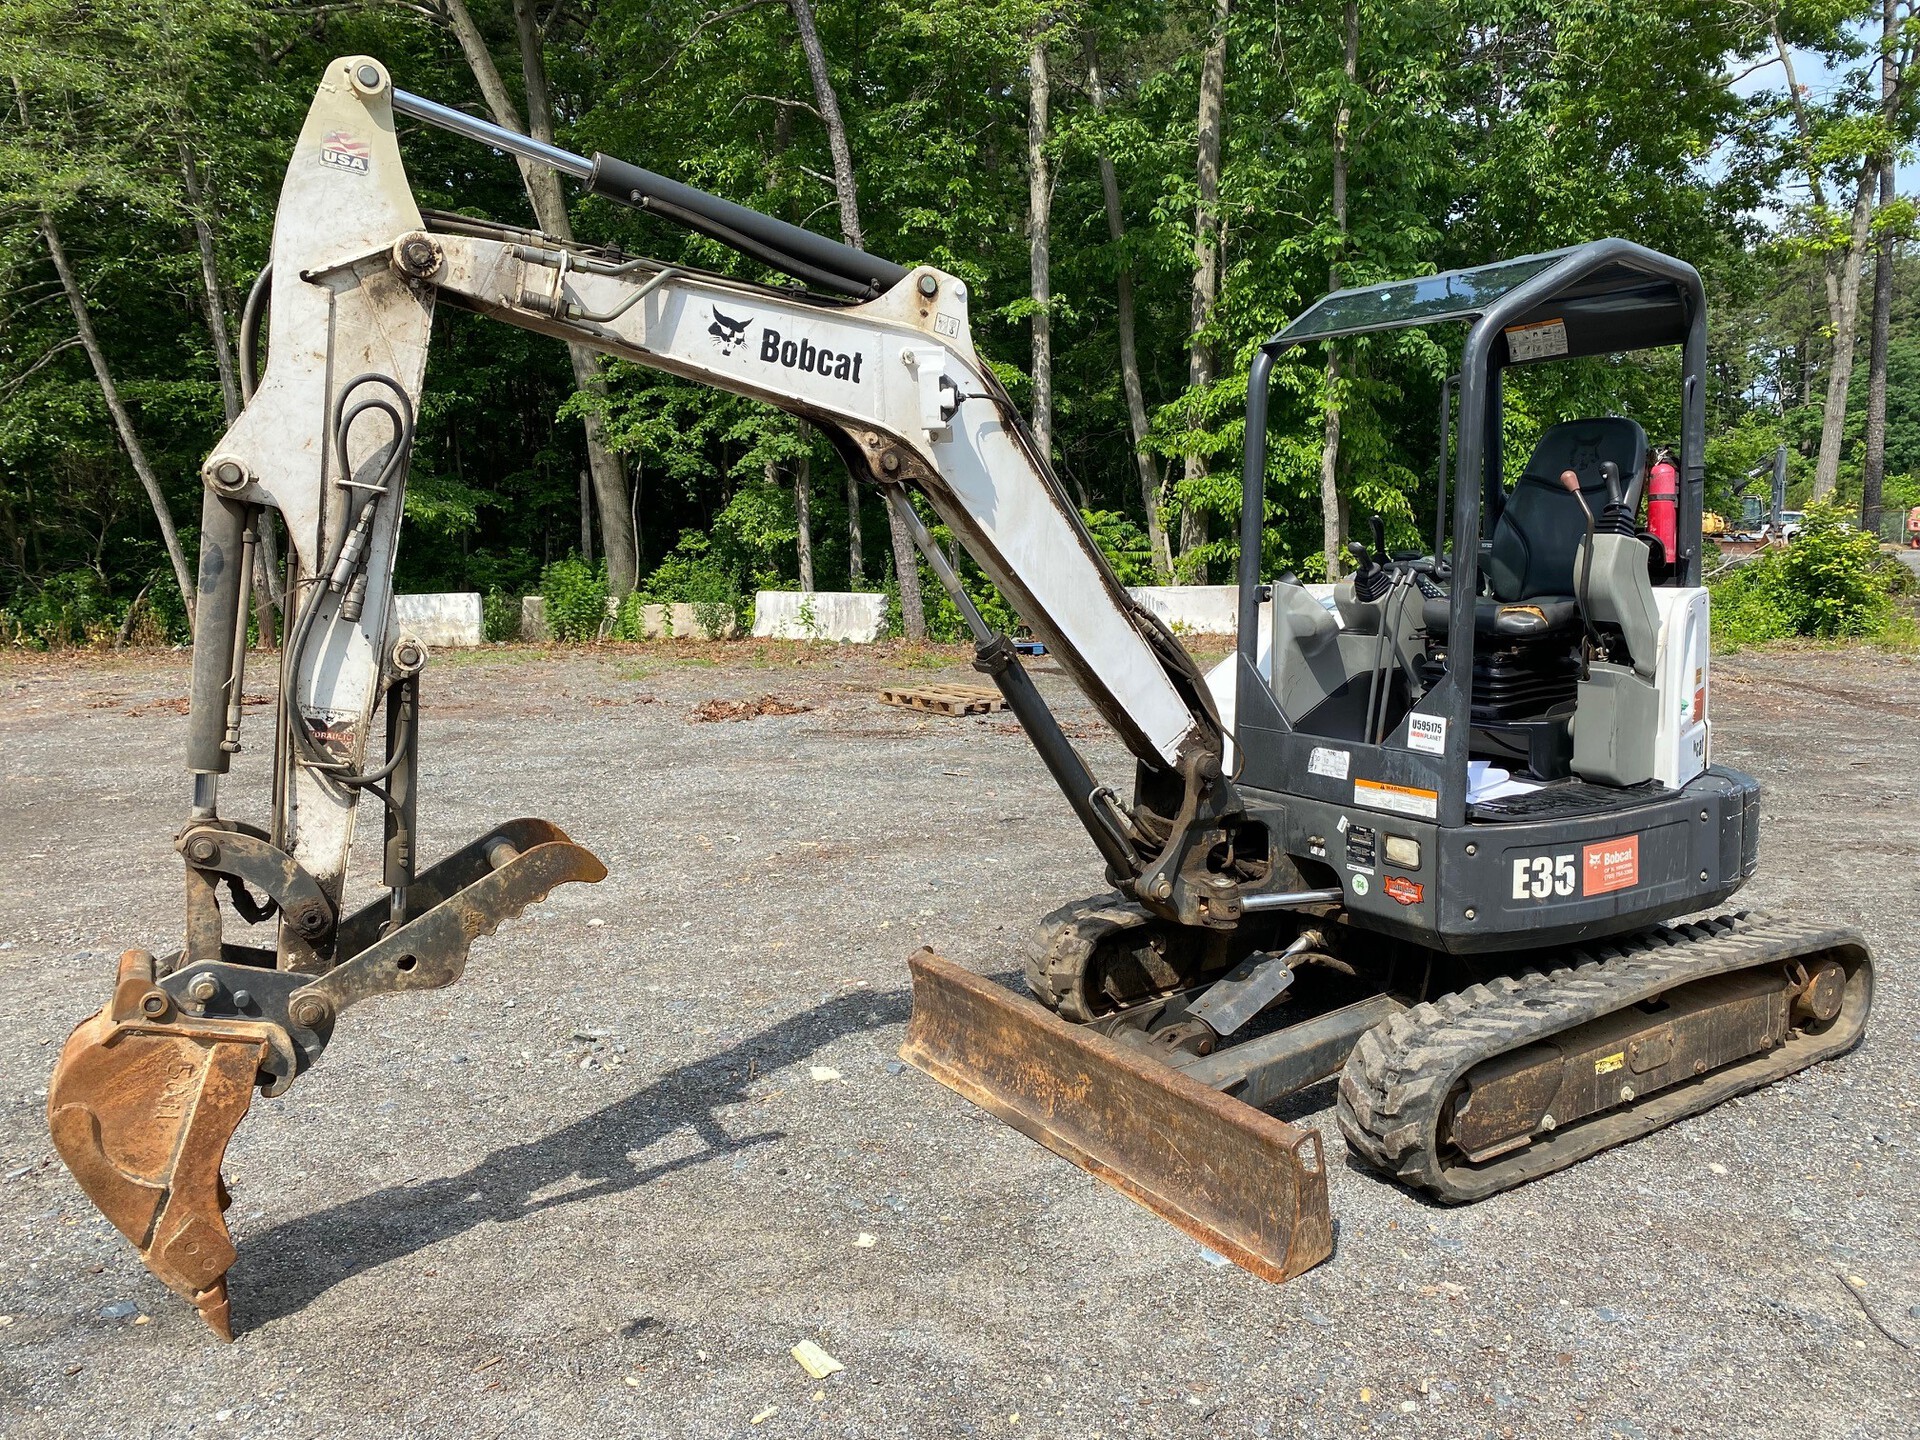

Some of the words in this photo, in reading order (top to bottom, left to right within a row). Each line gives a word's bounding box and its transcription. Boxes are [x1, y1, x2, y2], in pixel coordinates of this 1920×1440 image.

[323, 150, 365, 170] USA
[760, 328, 863, 384] Bobcat
[312, 731, 353, 741] DRAULIC
[1412, 719, 1442, 734] U595175
[1386, 785, 1410, 794] WARNING
[1604, 847, 1632, 866] Bobcat
[1512, 854, 1576, 900] E35
